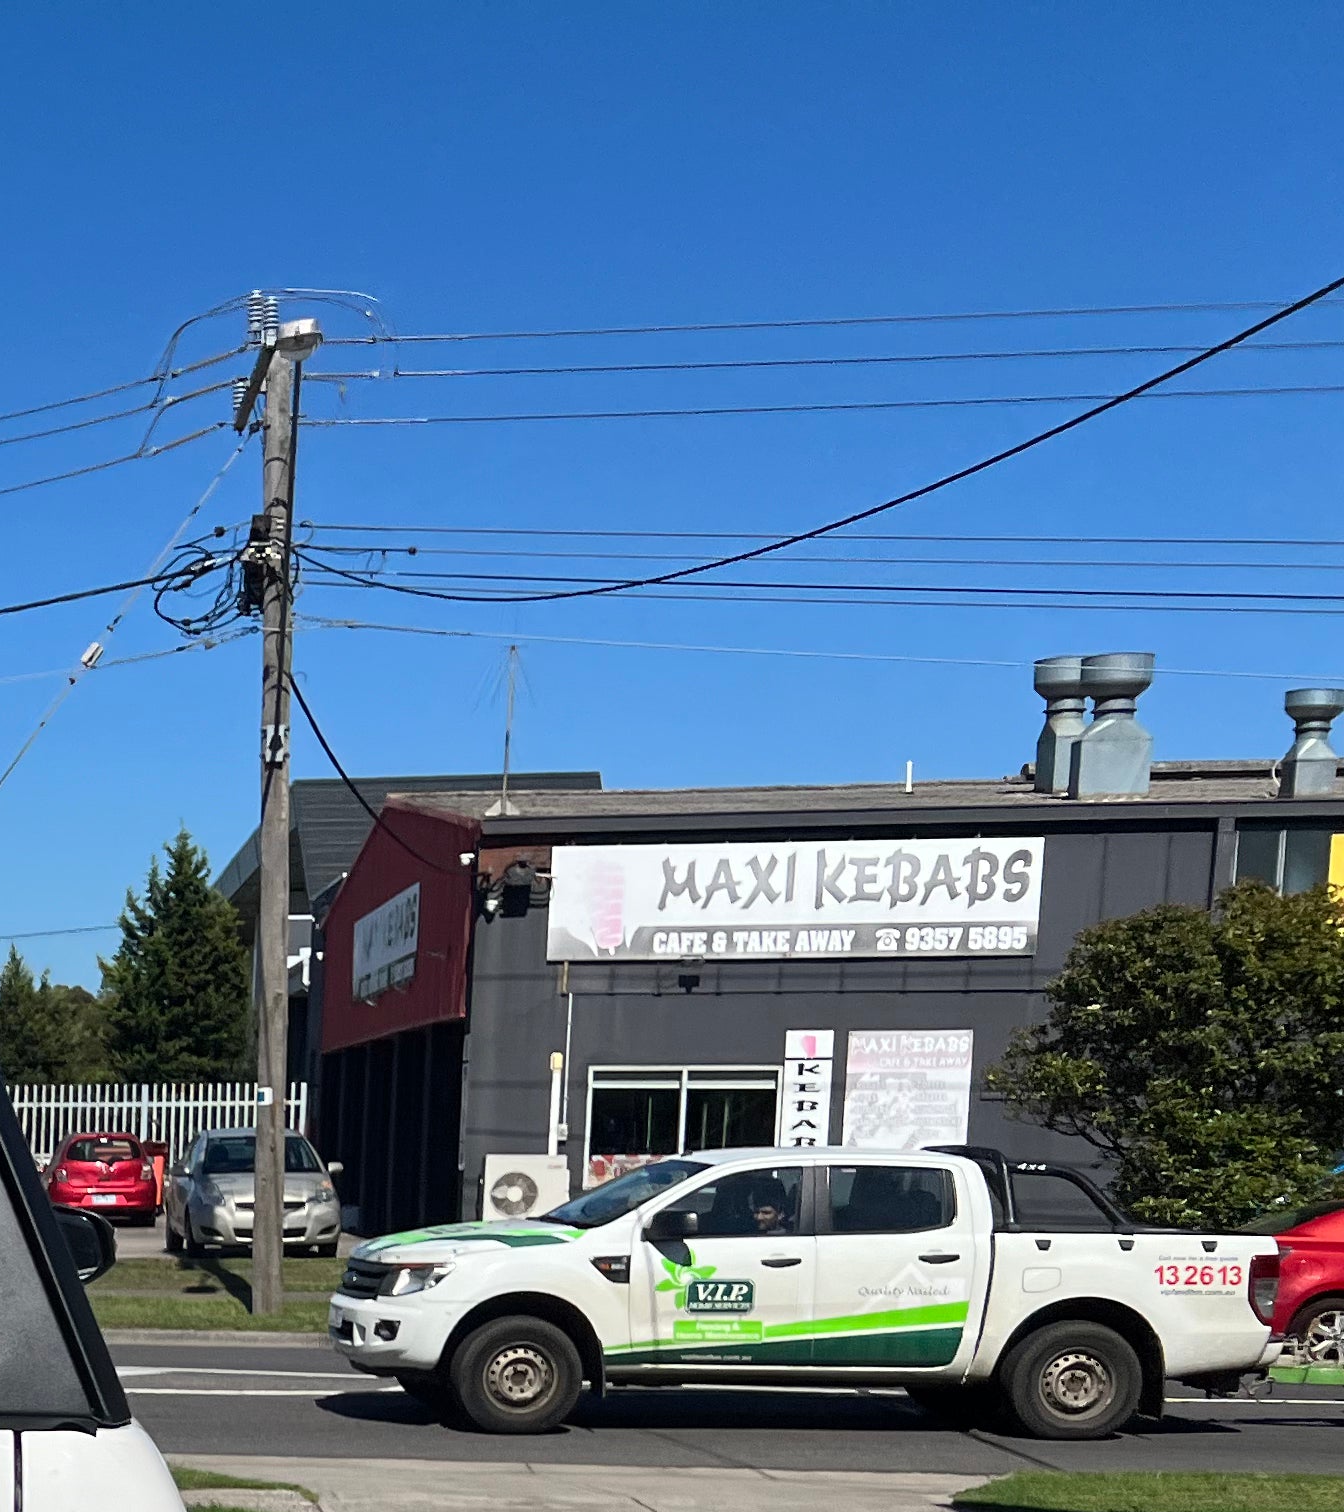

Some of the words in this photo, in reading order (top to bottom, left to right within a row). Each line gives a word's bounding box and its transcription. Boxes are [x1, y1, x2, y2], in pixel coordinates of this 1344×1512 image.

[658, 852, 797, 911] MAXI
[815, 846, 1033, 910] KEBABS
[653, 931, 707, 953] CAFE
[712, 931, 727, 952] &
[733, 931, 791, 953] TAKE
[794, 929, 856, 952] AWAY
[905, 928, 963, 951] 9357
[968, 927, 1027, 950] 5895
[852, 1036, 896, 1055] MAXI
[1155, 1265, 1179, 1285] 13
[1184, 1265, 1213, 1285] 26
[1218, 1265, 1242, 1285] 13
